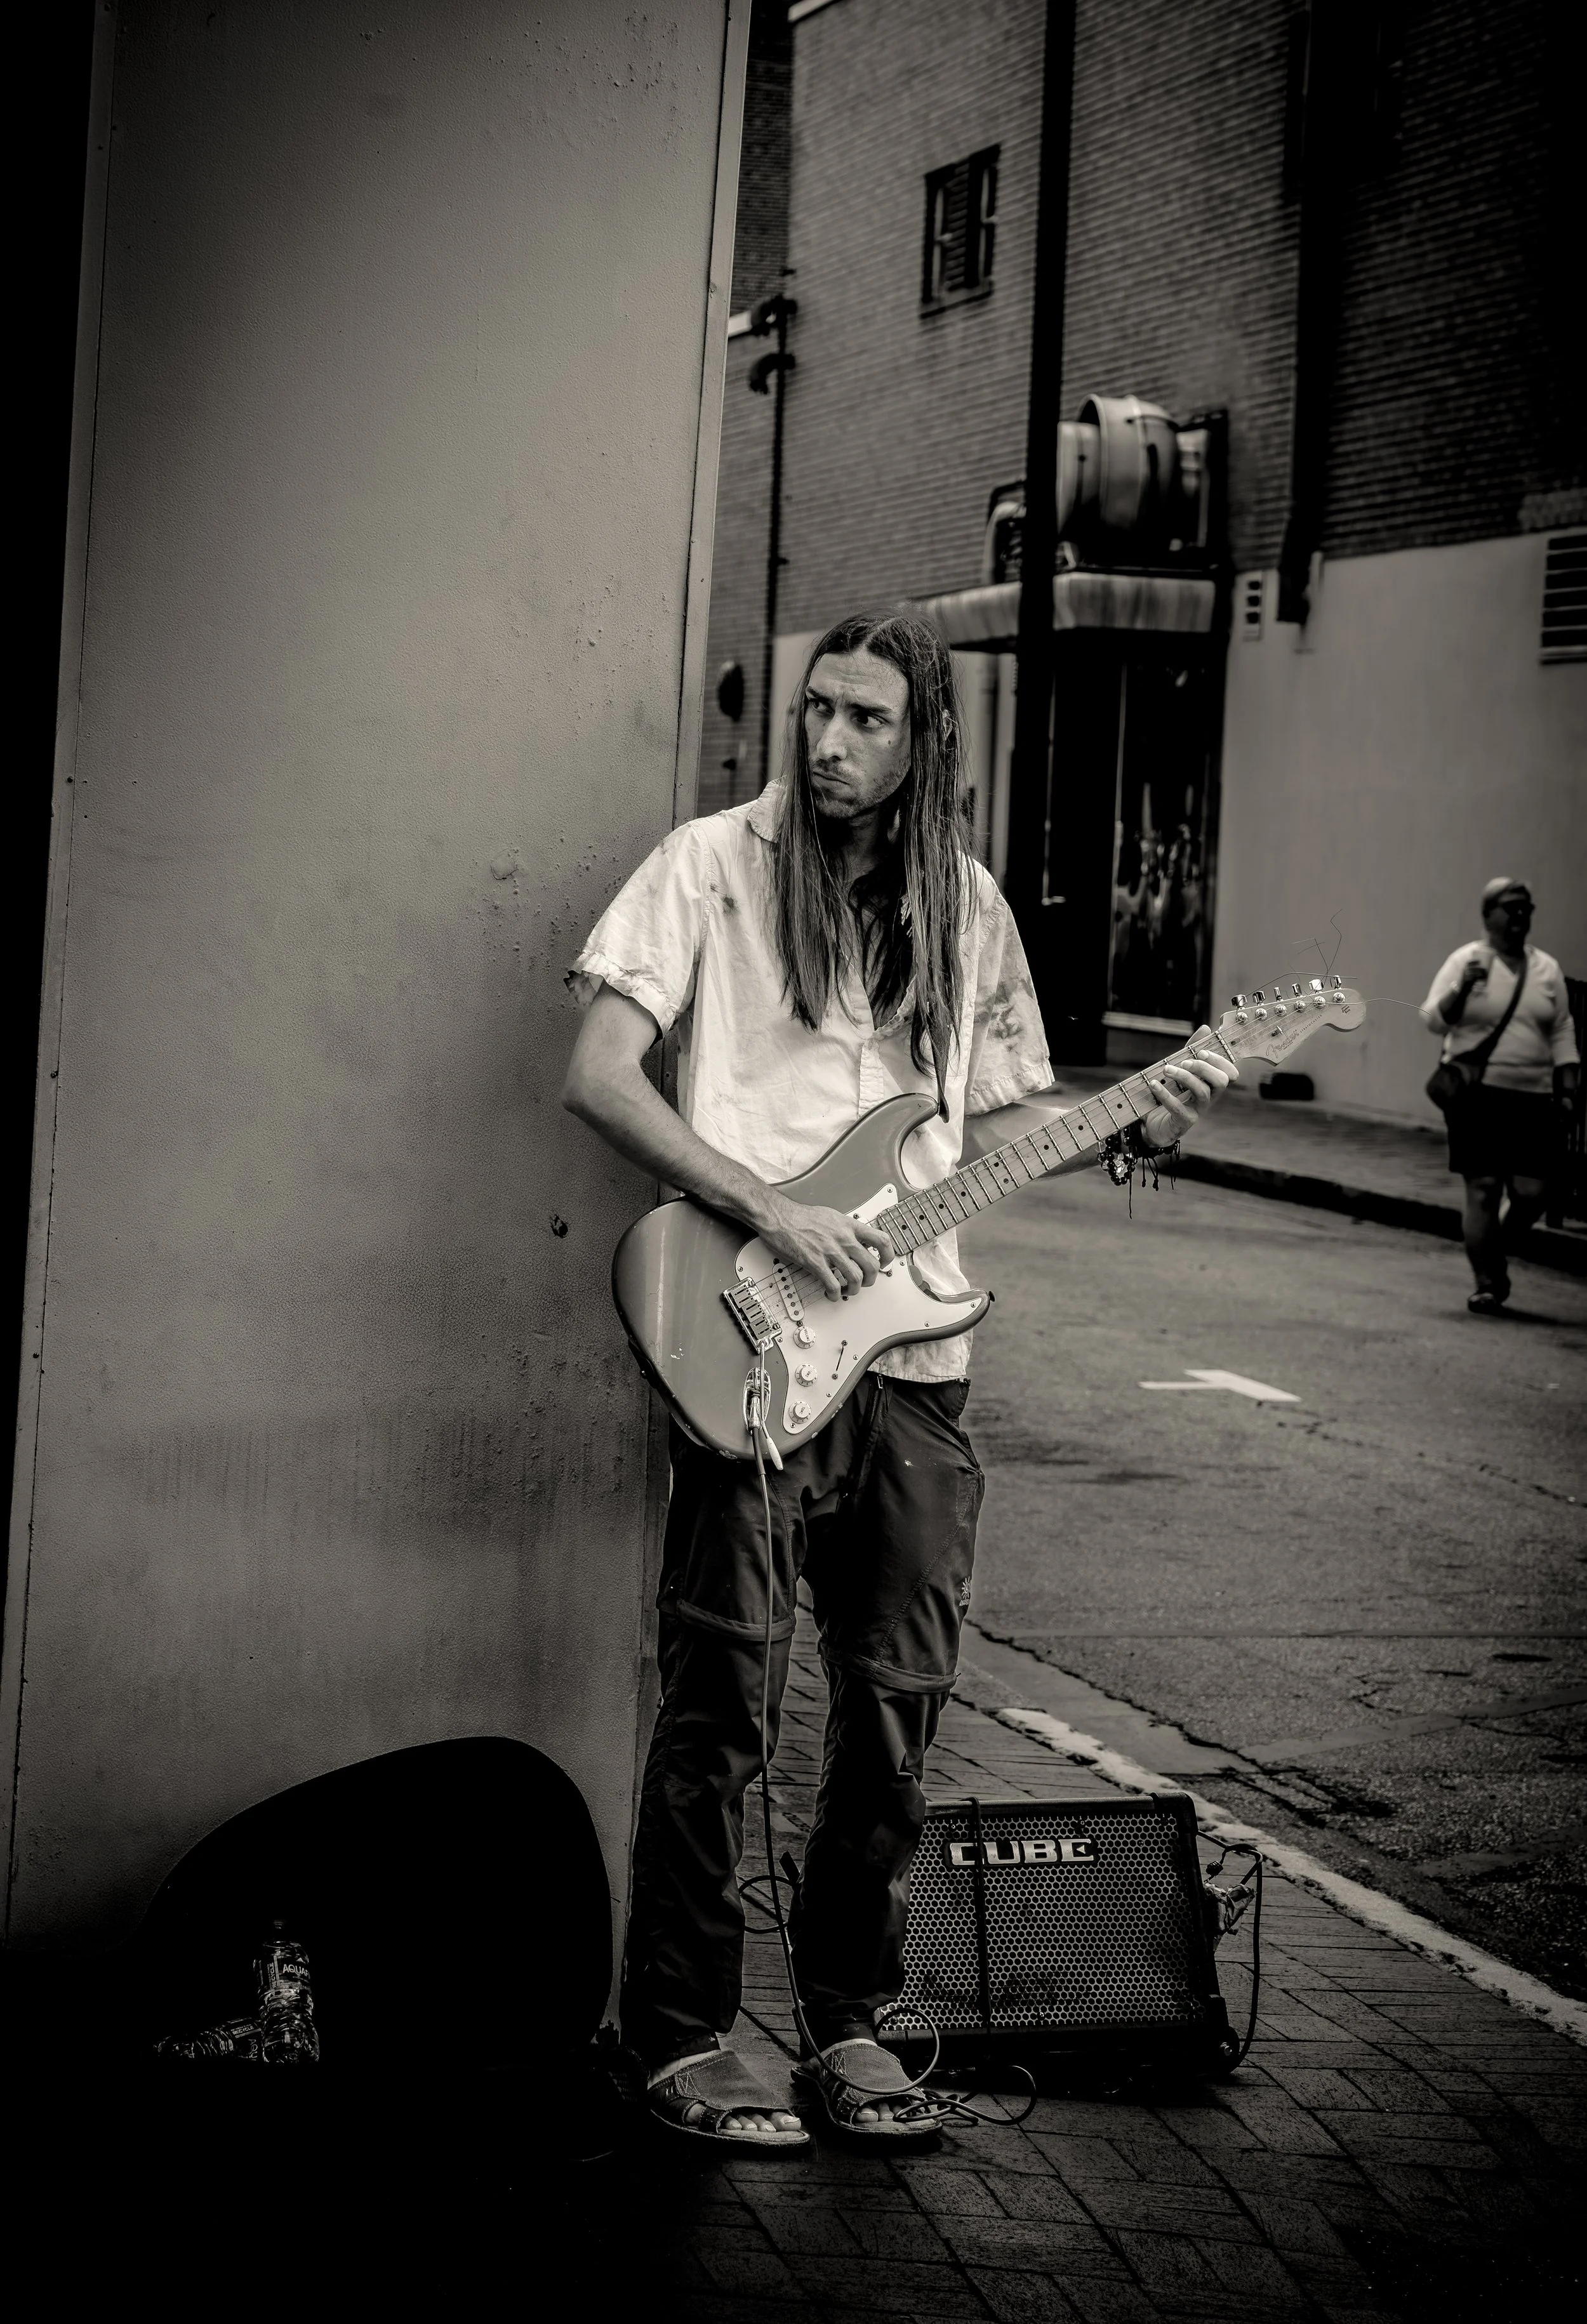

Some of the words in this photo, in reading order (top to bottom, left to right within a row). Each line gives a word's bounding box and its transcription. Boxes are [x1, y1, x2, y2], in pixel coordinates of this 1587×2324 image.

[1266, 1029, 1299, 1059] Fender
[950, 1839, 1094, 1865] CUBE
[232, 2025, 255, 2035] RECYCLE
[248, 2038, 258, 2061] AQU
